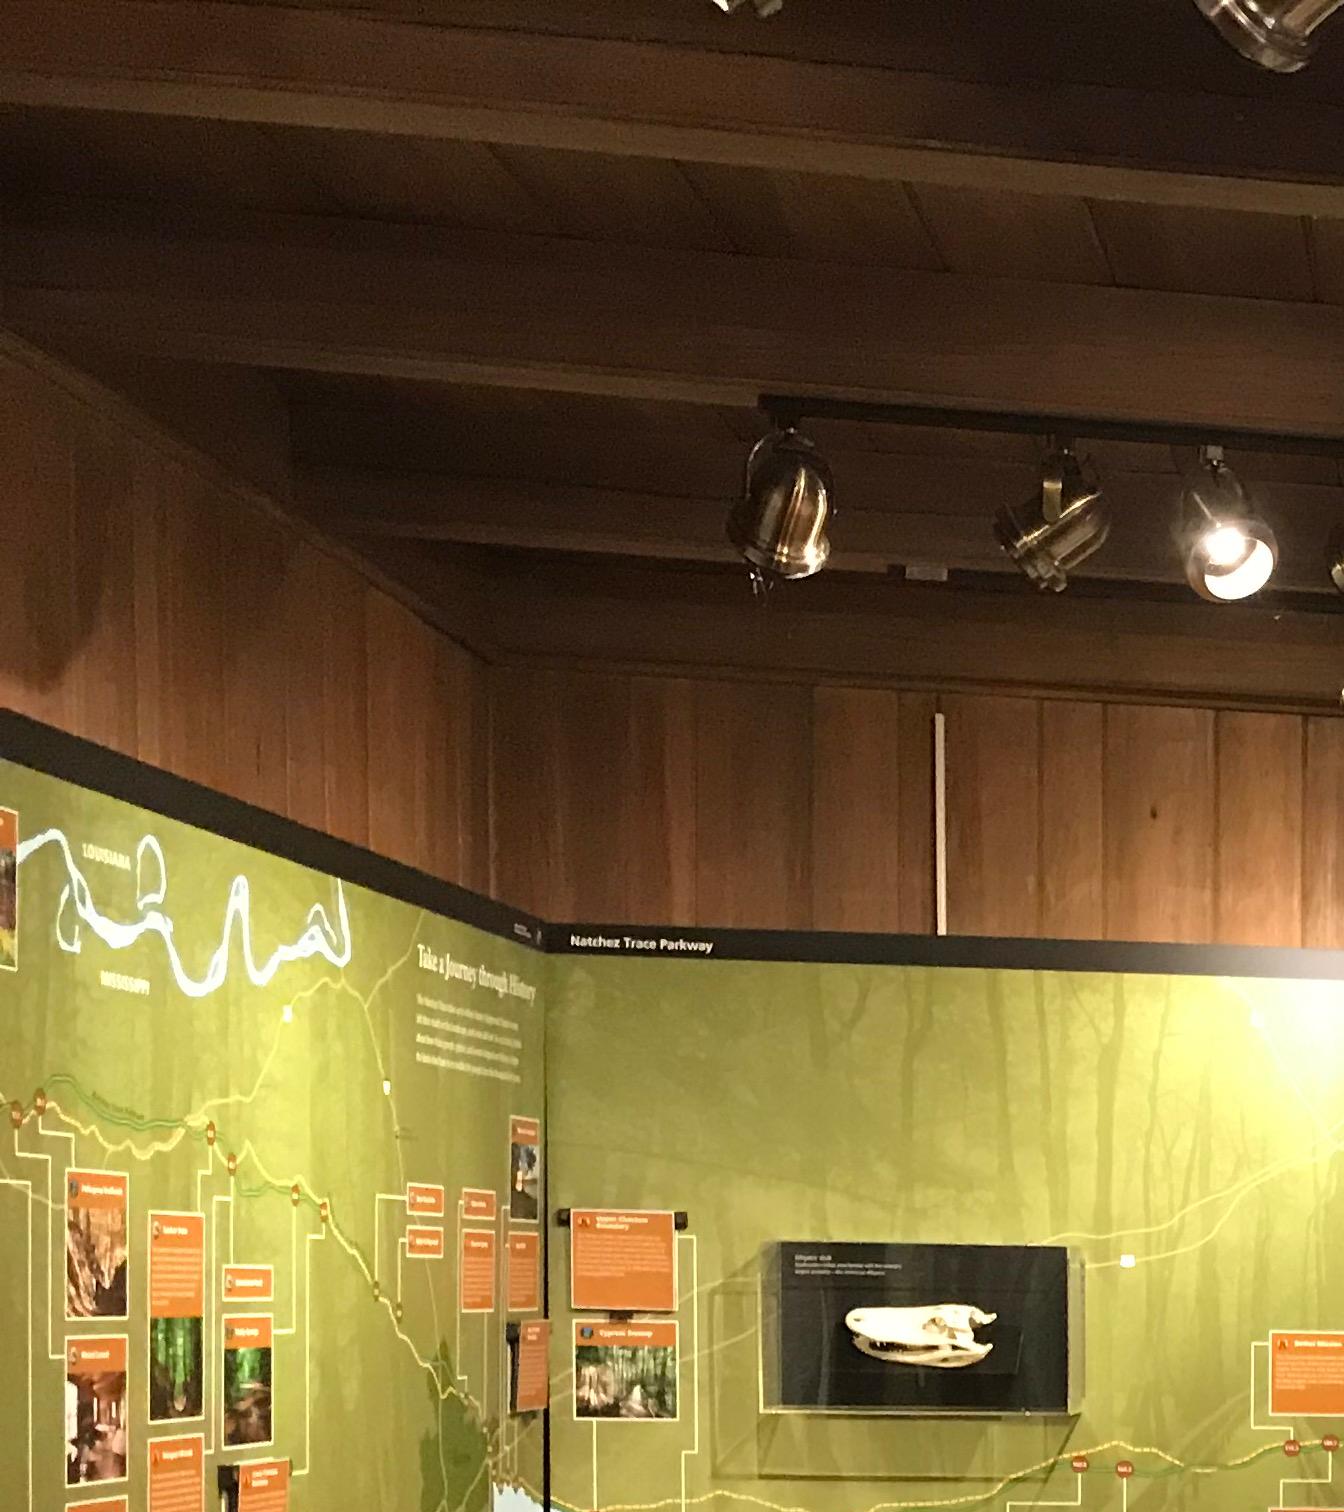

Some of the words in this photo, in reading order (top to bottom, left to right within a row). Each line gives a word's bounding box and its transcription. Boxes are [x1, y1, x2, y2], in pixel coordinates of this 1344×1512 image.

[570, 934, 620, 949] Natchez
[624, 937, 657, 950] Trace
[660, 938, 714, 954] Parkway
[417, 943, 438, 972] Take
[444, 953, 477, 990] Journey
[478, 964, 508, 998] through
[509, 973, 537, 1007] History
